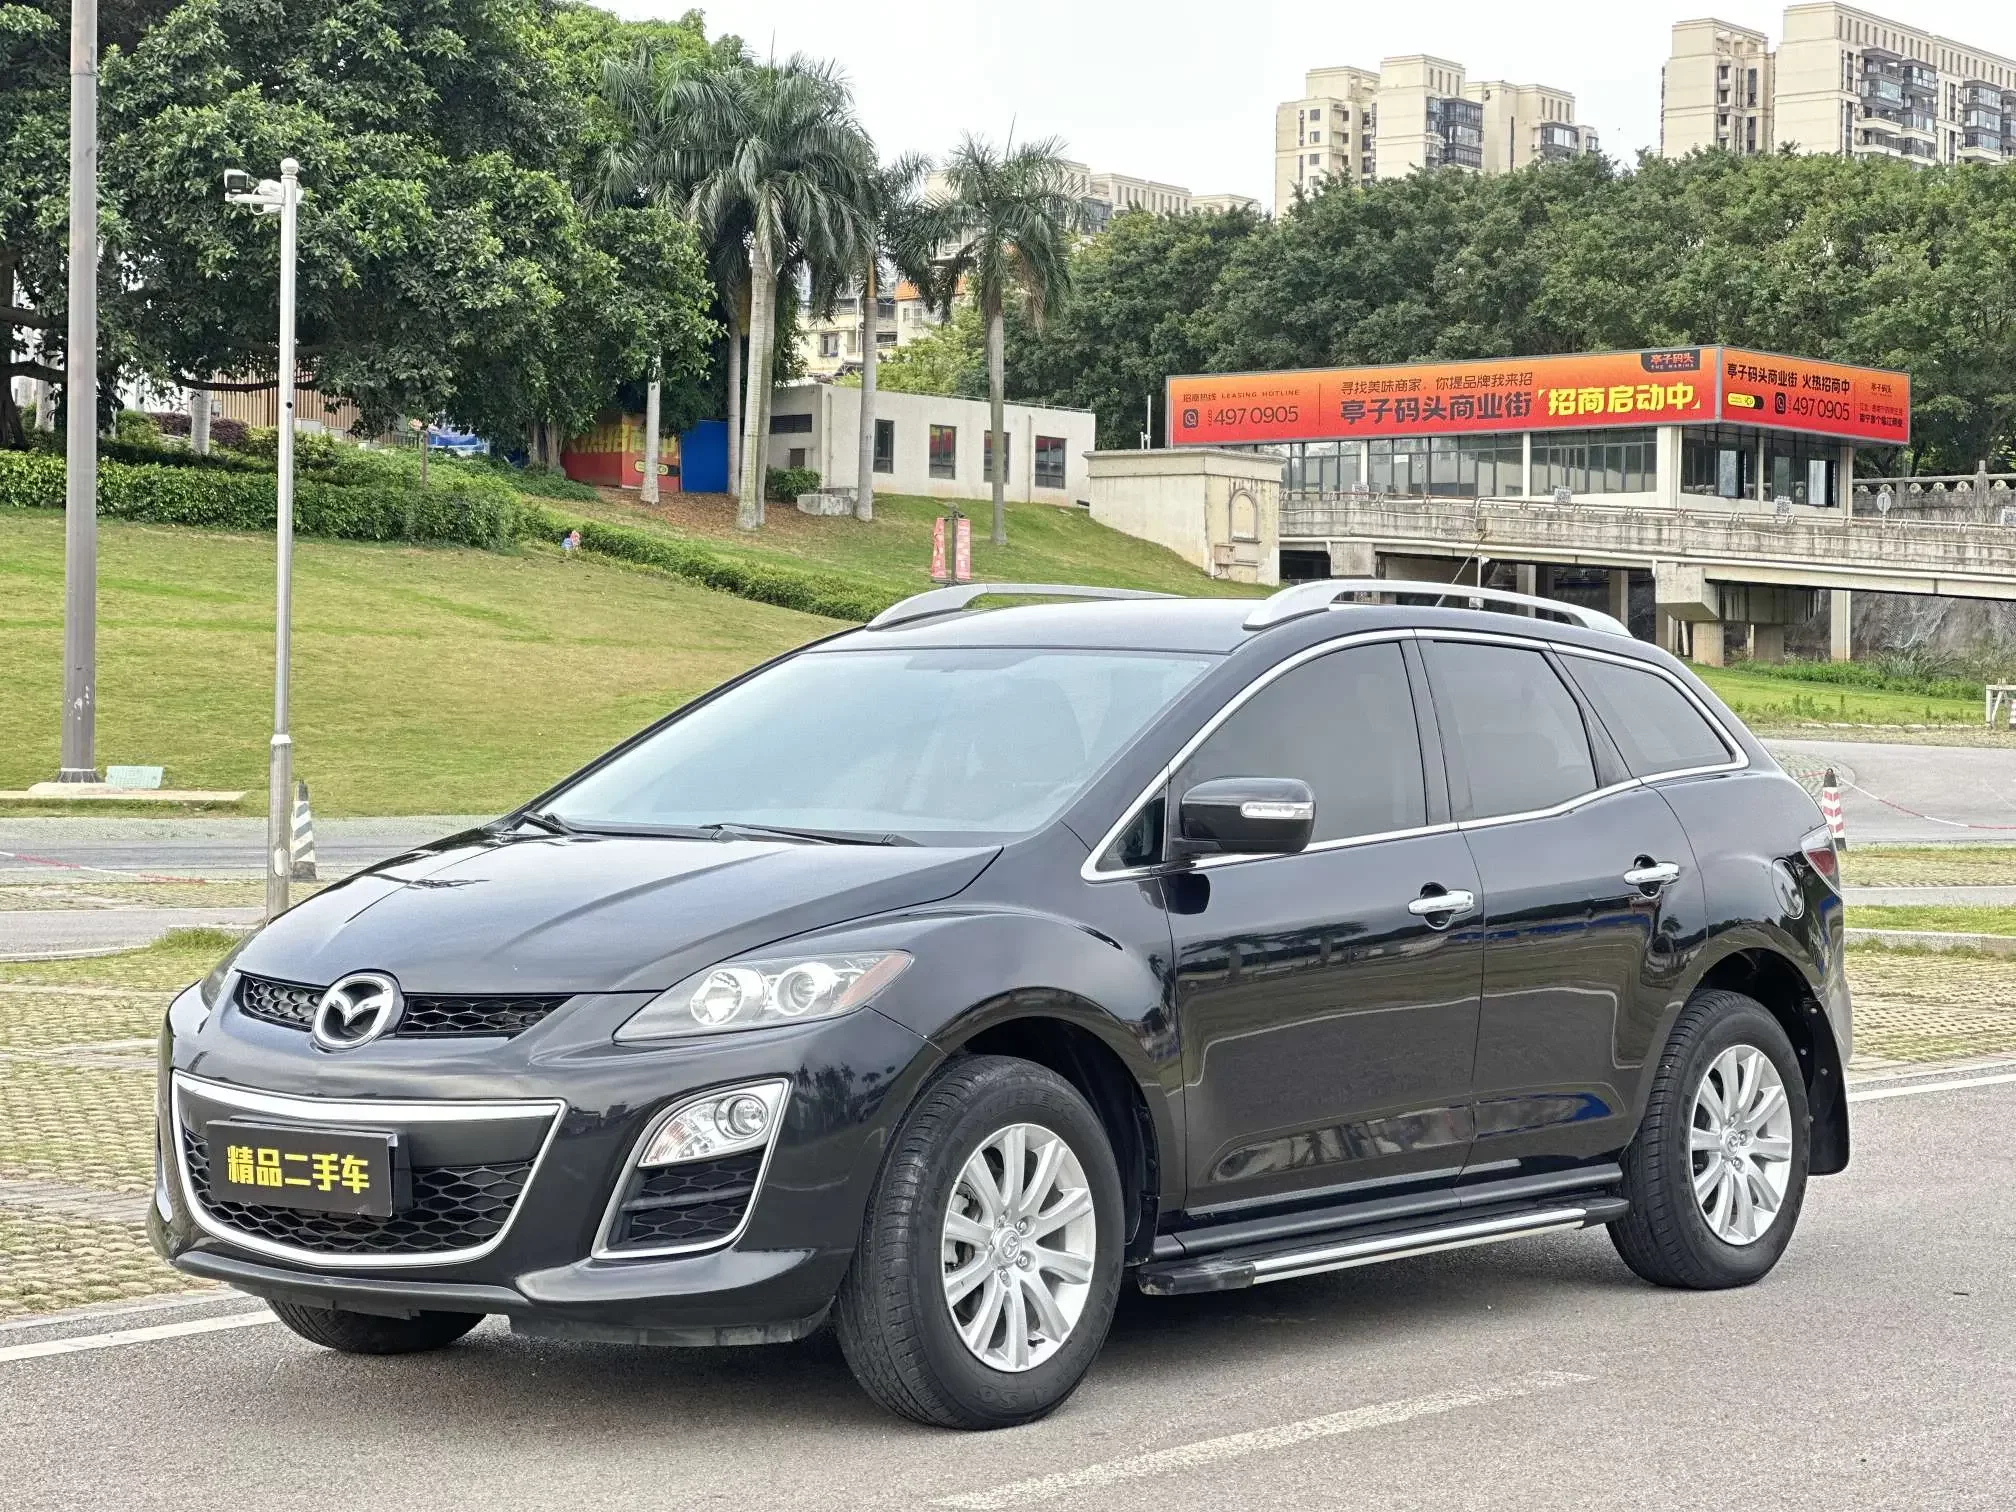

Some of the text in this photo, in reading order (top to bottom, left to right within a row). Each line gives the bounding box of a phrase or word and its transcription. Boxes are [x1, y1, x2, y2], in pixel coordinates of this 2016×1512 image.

[1221, 389, 1300, 399] LEASING HOTLINE
[1727, 363, 1850, 396] 亭子码头商业街 火热招商中
[1183, 393, 1217, 403] 招商热线
[1340, 382, 1694, 425] 亭子码头商业街 招商启动中
[227, 1145, 370, 1194] 精品二手车
